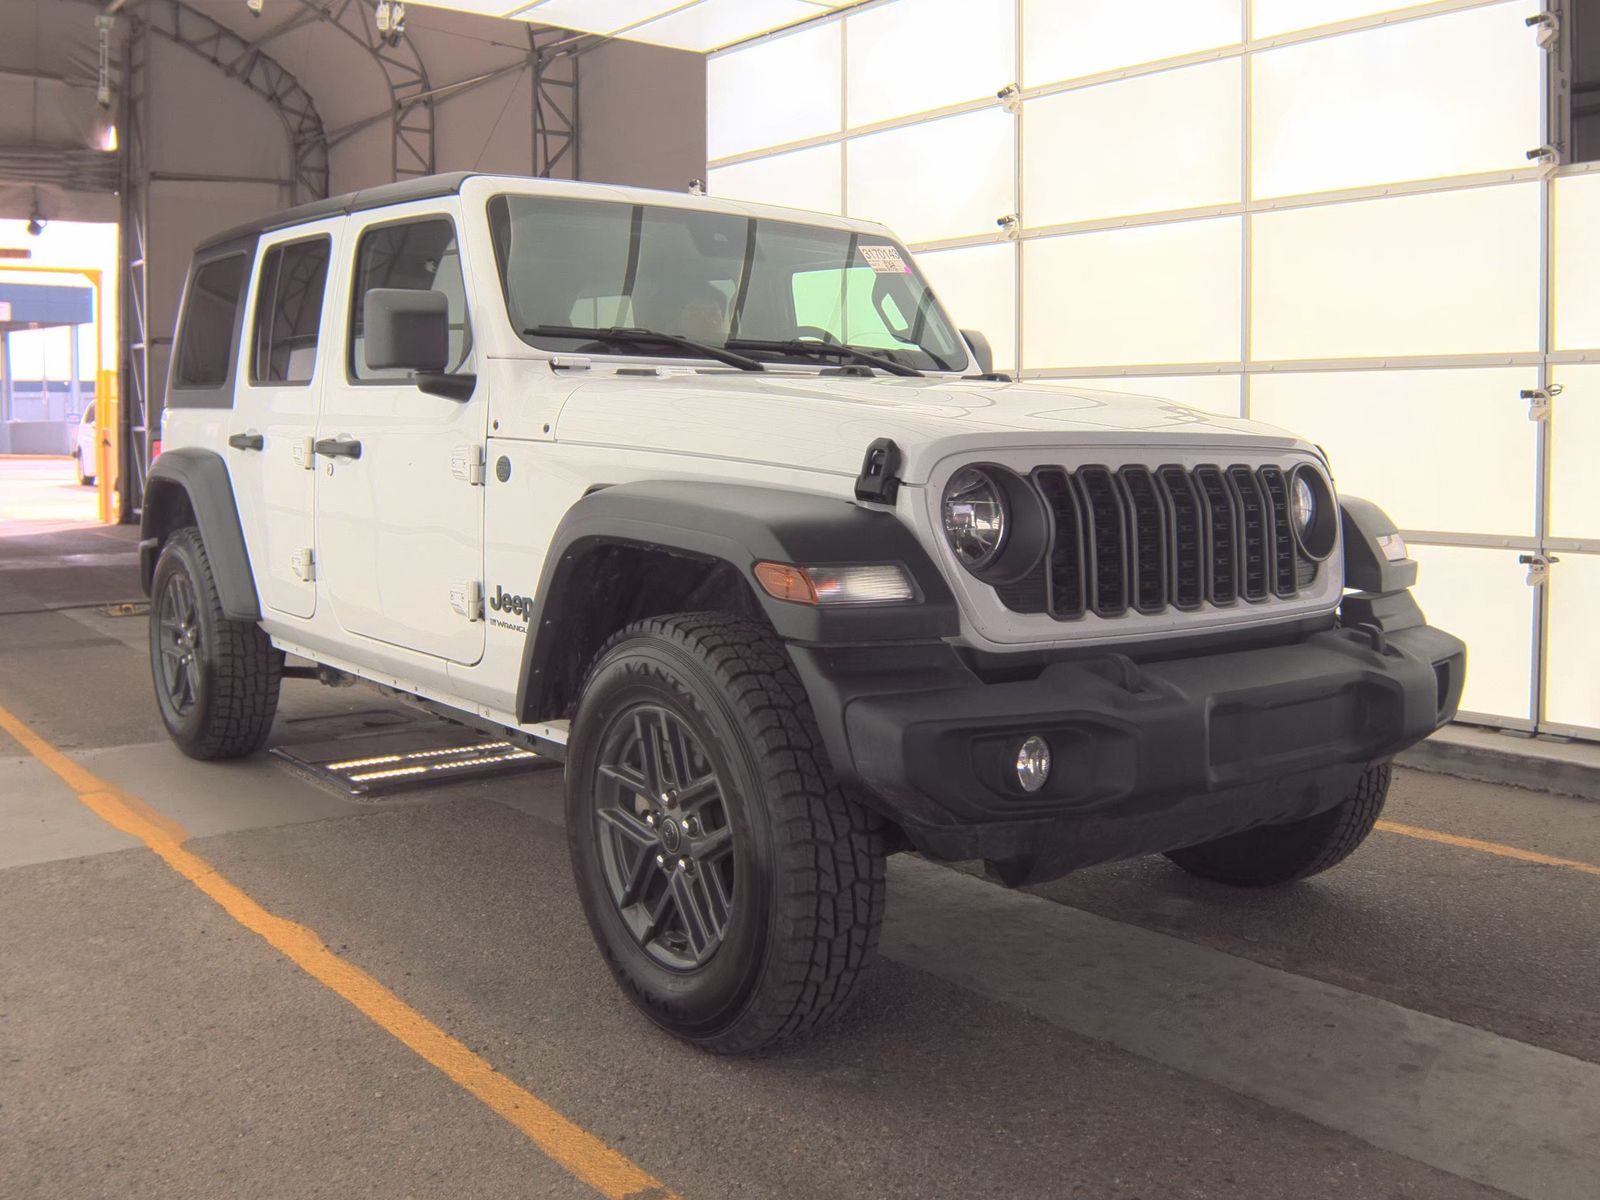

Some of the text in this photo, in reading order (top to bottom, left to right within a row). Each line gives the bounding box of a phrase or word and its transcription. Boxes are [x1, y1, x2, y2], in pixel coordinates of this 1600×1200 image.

[862, 248, 900, 260] 3170143
[490, 585, 534, 622] Jeep
[497, 620, 529, 634] WRANGL
